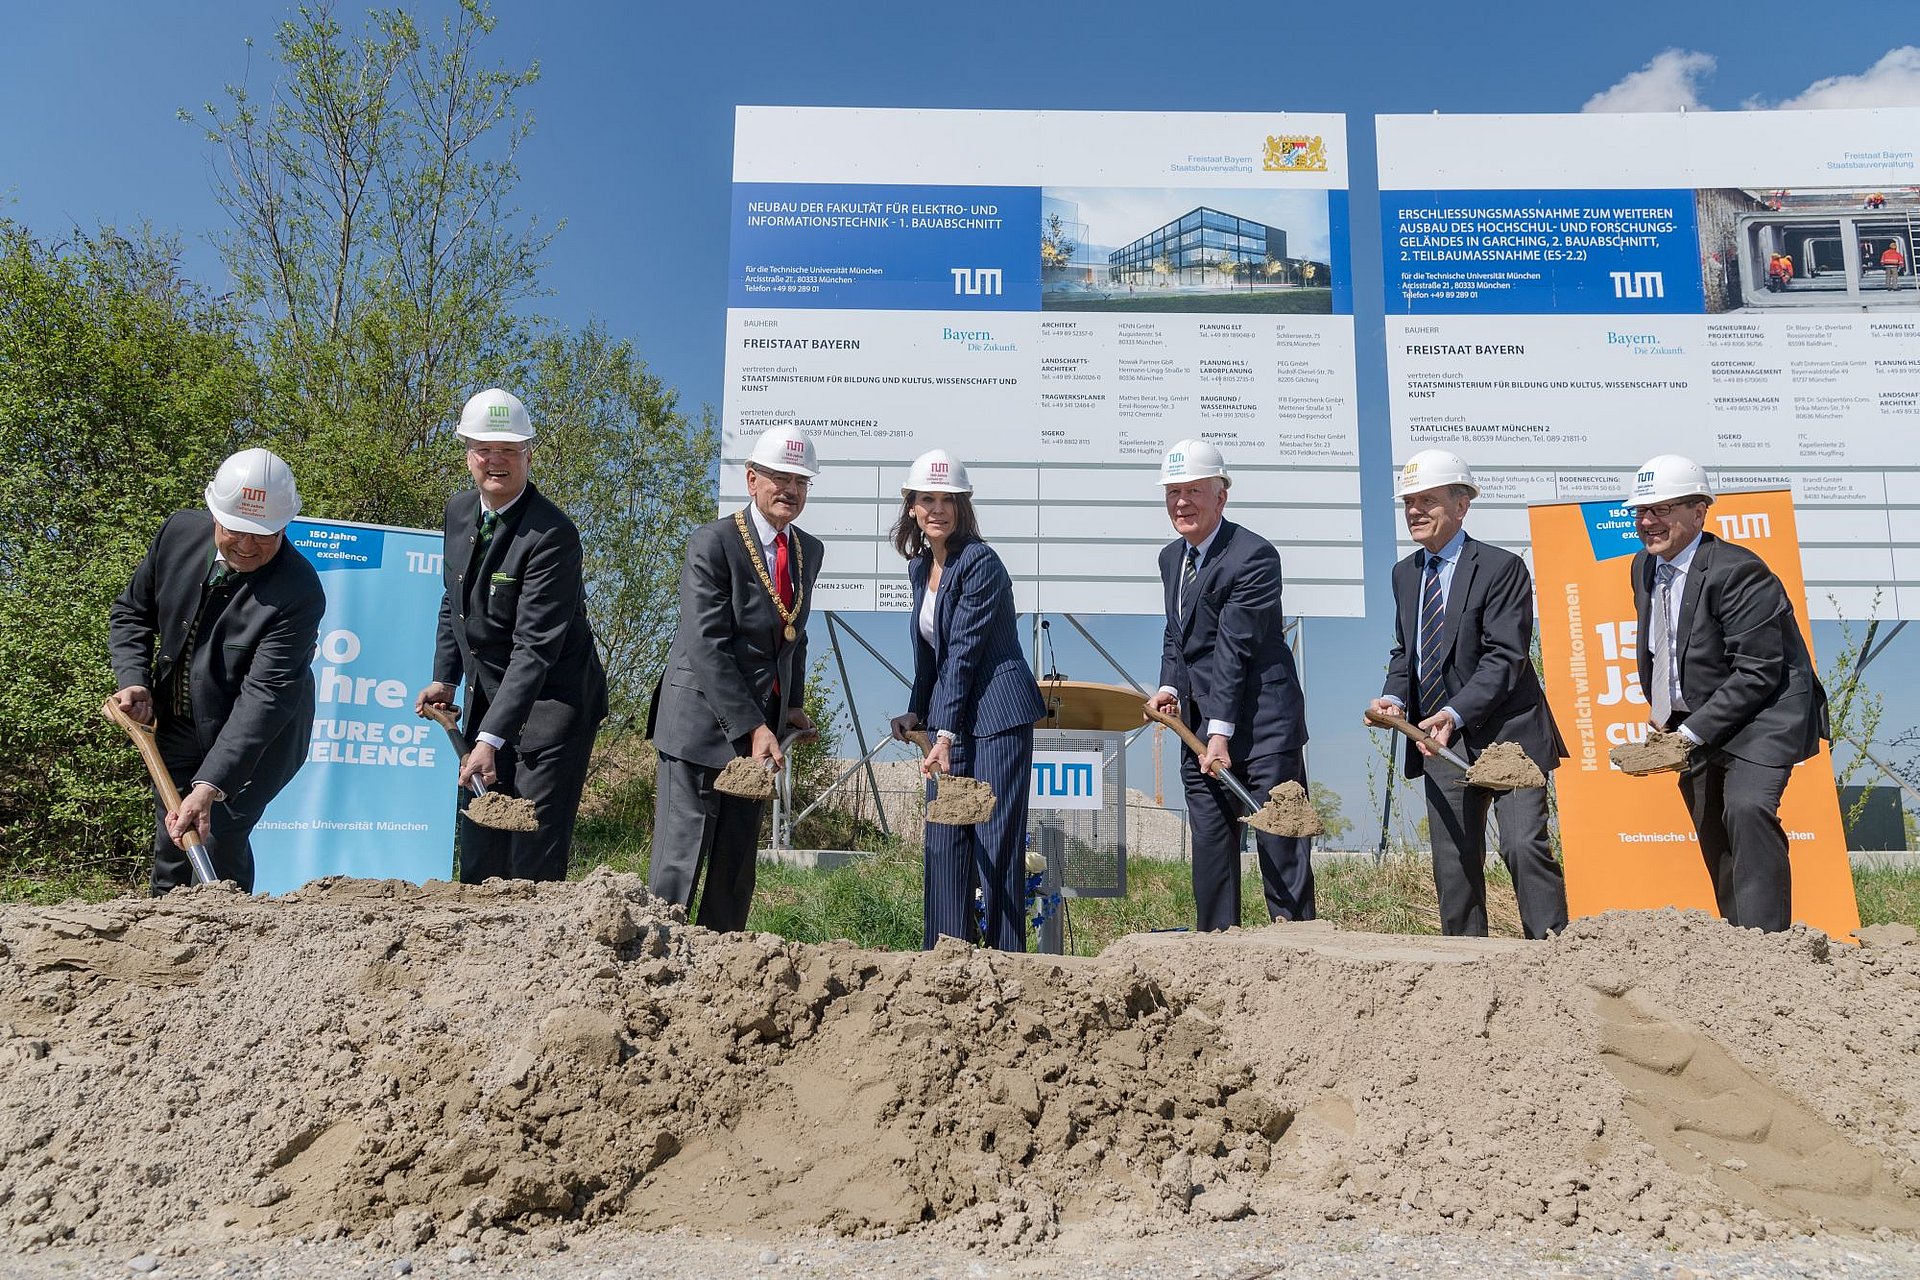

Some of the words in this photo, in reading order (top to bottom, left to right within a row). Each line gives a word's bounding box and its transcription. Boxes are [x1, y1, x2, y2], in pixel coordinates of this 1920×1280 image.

[1187, 154, 1222, 163] Freistaat
[1224, 155, 1253, 165] Bayern
[1844, 152, 1880, 160] Freistaat
[1883, 151, 1912, 160] Bayern
[1170, 164, 1253, 174] Staatsbauverwaltung
[1827, 161, 1914, 169] Staatsbauverwaltung
[749, 202, 797, 212] NEUBAU
[801, 203, 823, 213] DER
[827, 202, 883, 213] FAKULTÄT
[886, 202, 908, 213] FÜR
[912, 204, 967, 214] ELEKTRO-
[971, 205, 997, 215] UND
[1399, 208, 1580, 219] ERSCHLIESSUNGSMASSNAHME
[1583, 208, 1610, 219] ZUM
[1613, 208, 1673, 219] WEITEREN
[748, 216, 889, 227] INFORMATIONSTECHNIK
[900, 218, 908, 228] 1.
[912, 218, 1002, 229] BAUABSCHNITT
[1399, 223, 1448, 233] AUSBAU
[1451, 223, 1474, 233] DES
[1477, 222, 1557, 233] HOCHSCHUL-
[1561, 222, 1587, 232] UND
[1591, 222, 1677, 234] FORSCHUNGS-
[1400, 235, 1463, 247] GELÄNDES
[1467, 236, 1479, 246] IN
[1482, 236, 1549, 247] GARCHING,
[1552, 237, 1562, 246] 2.
[1565, 236, 1659, 249] BAUABSCHNITT,
[1401, 251, 1411, 261] 2.
[1412, 250, 1541, 261] TEILBAUMASSNAHME
[1544, 249, 1587, 261] (ES-2.2)
[745, 275, 784, 283] Arcisstraße
[951, 268, 1001, 295] TUM
[1402, 282, 1441, 290] Arcisstraße
[1610, 272, 1664, 298] TUM
[1402, 291, 1429, 300] Telefon
[943, 328, 996, 345] Bayern.
[1608, 332, 1660, 348] Bayern.
[744, 339, 809, 349] FREISTAAT
[812, 340, 860, 349] BAYERN
[968, 343, 981, 351] Die
[983, 343, 1017, 351] Zukunft.
[1407, 345, 1472, 355] FREISTAAT
[1475, 345, 1524, 354] BAYERN
[827, 375, 842, 383] FÜR
[488, 406, 509, 417] TUM
[741, 408, 773, 416] vertreten
[830, 419, 872, 427] MÜNCHEN
[1411, 434, 1460, 443] Ludwigstraße
[786, 440, 804, 452] TUM
[931, 463, 949, 473] TUM
[1638, 472, 1654, 482] TUM
[242, 487, 266, 502] TUM
[1609, 509, 1628, 518] 150
[1596, 520, 1633, 530] culture
[1716, 513, 1771, 539] TUM
[309, 531, 327, 539] 150
[329, 532, 357, 542] Jahre
[295, 540, 328, 549] culture
[317, 551, 368, 562] excellence
[1565, 583, 1589, 694] willkommen
[1595, 620, 1638, 660] 15
[319, 667, 407, 708] hre
[313, 719, 385, 742] TURE
[389, 725, 430, 745] OF
[1575, 696, 1597, 771] Herzlich
[311, 742, 436, 767] ELLENCE
[1033, 762, 1092, 796] TUM
[255, 820, 308, 830] chnische
[311, 820, 373, 831] Universität
[377, 821, 428, 831] München
[1618, 832, 1685, 843] Technische
[1787, 831, 1815, 840] chen
